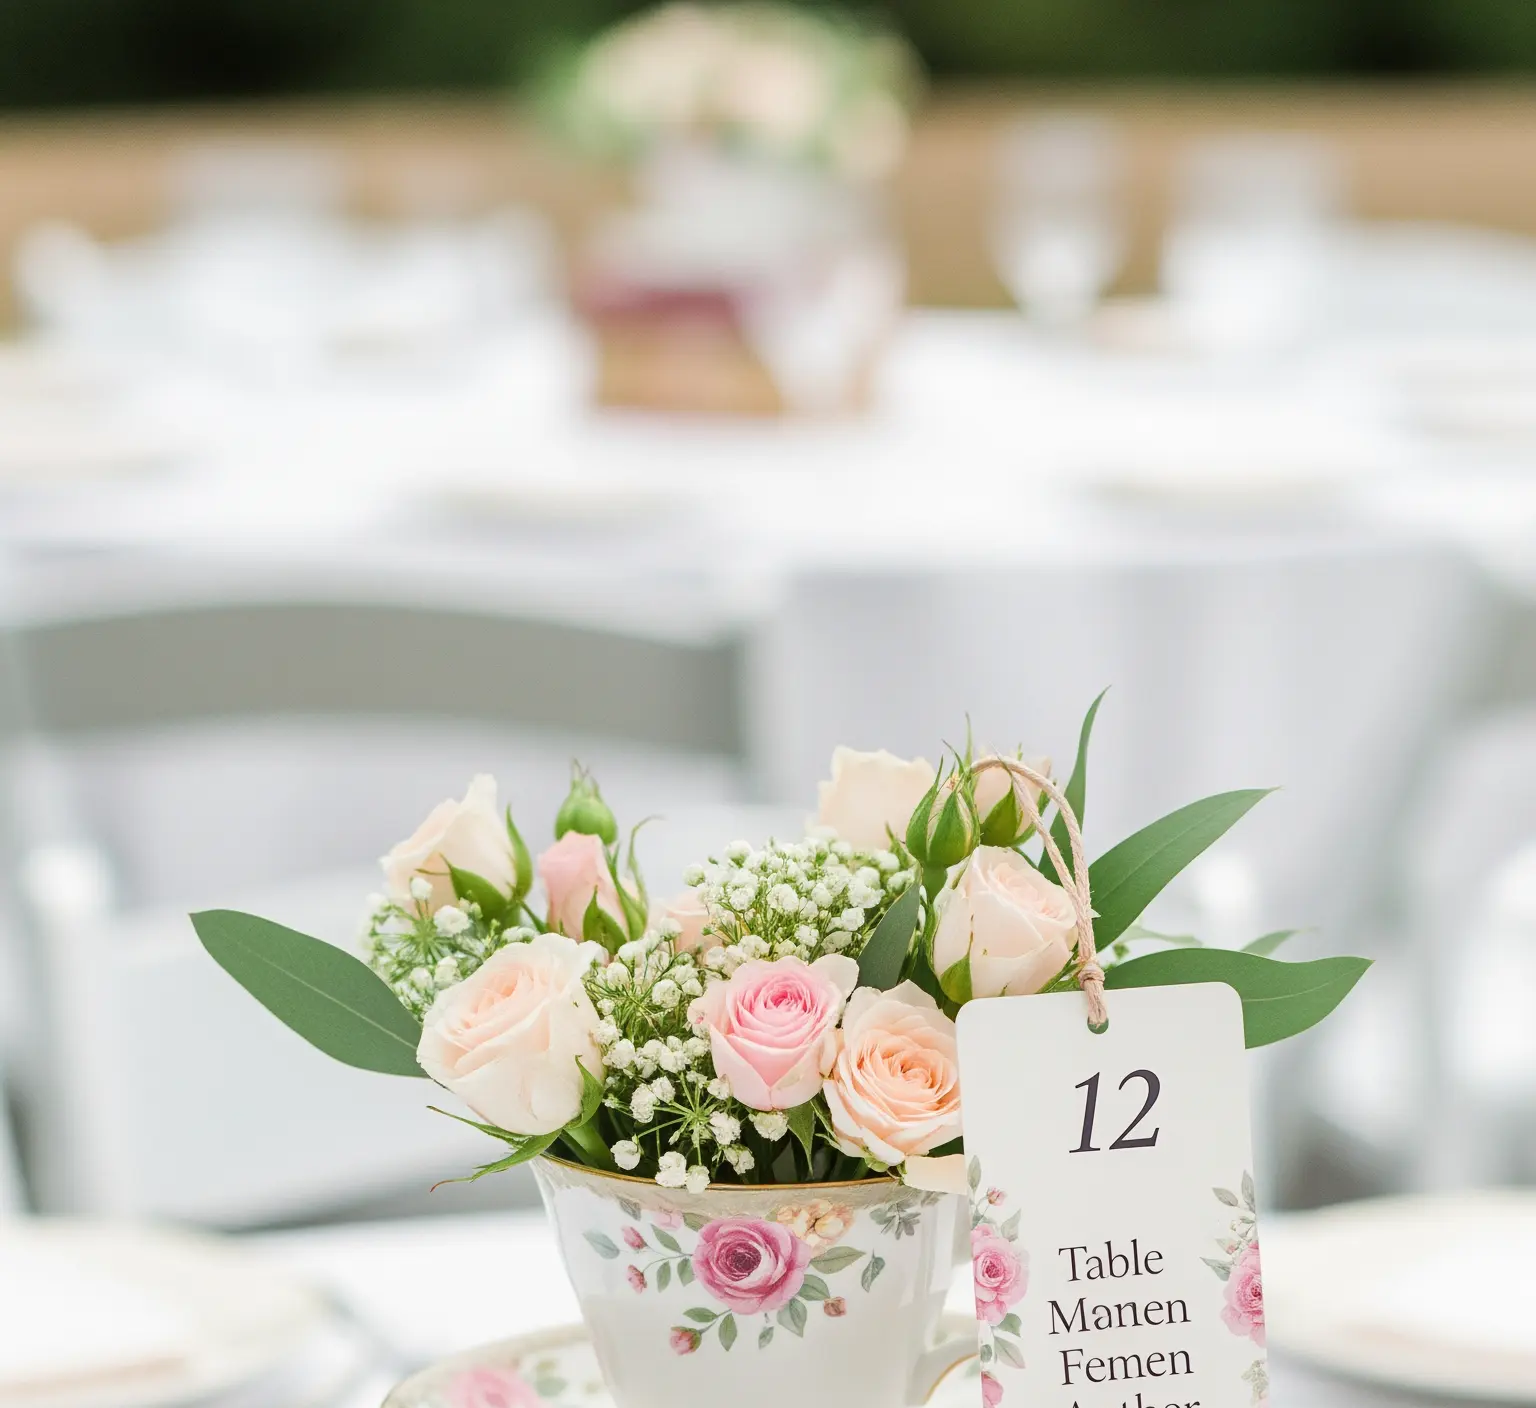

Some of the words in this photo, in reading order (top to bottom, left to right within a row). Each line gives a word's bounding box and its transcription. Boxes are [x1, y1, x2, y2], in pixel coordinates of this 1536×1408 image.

[1068, 1069, 1161, 1154] 12
[1057, 1238, 1165, 1282] Table
[1047, 1297, 1192, 1335] Manen
[1058, 1348, 1195, 1386] Femen
